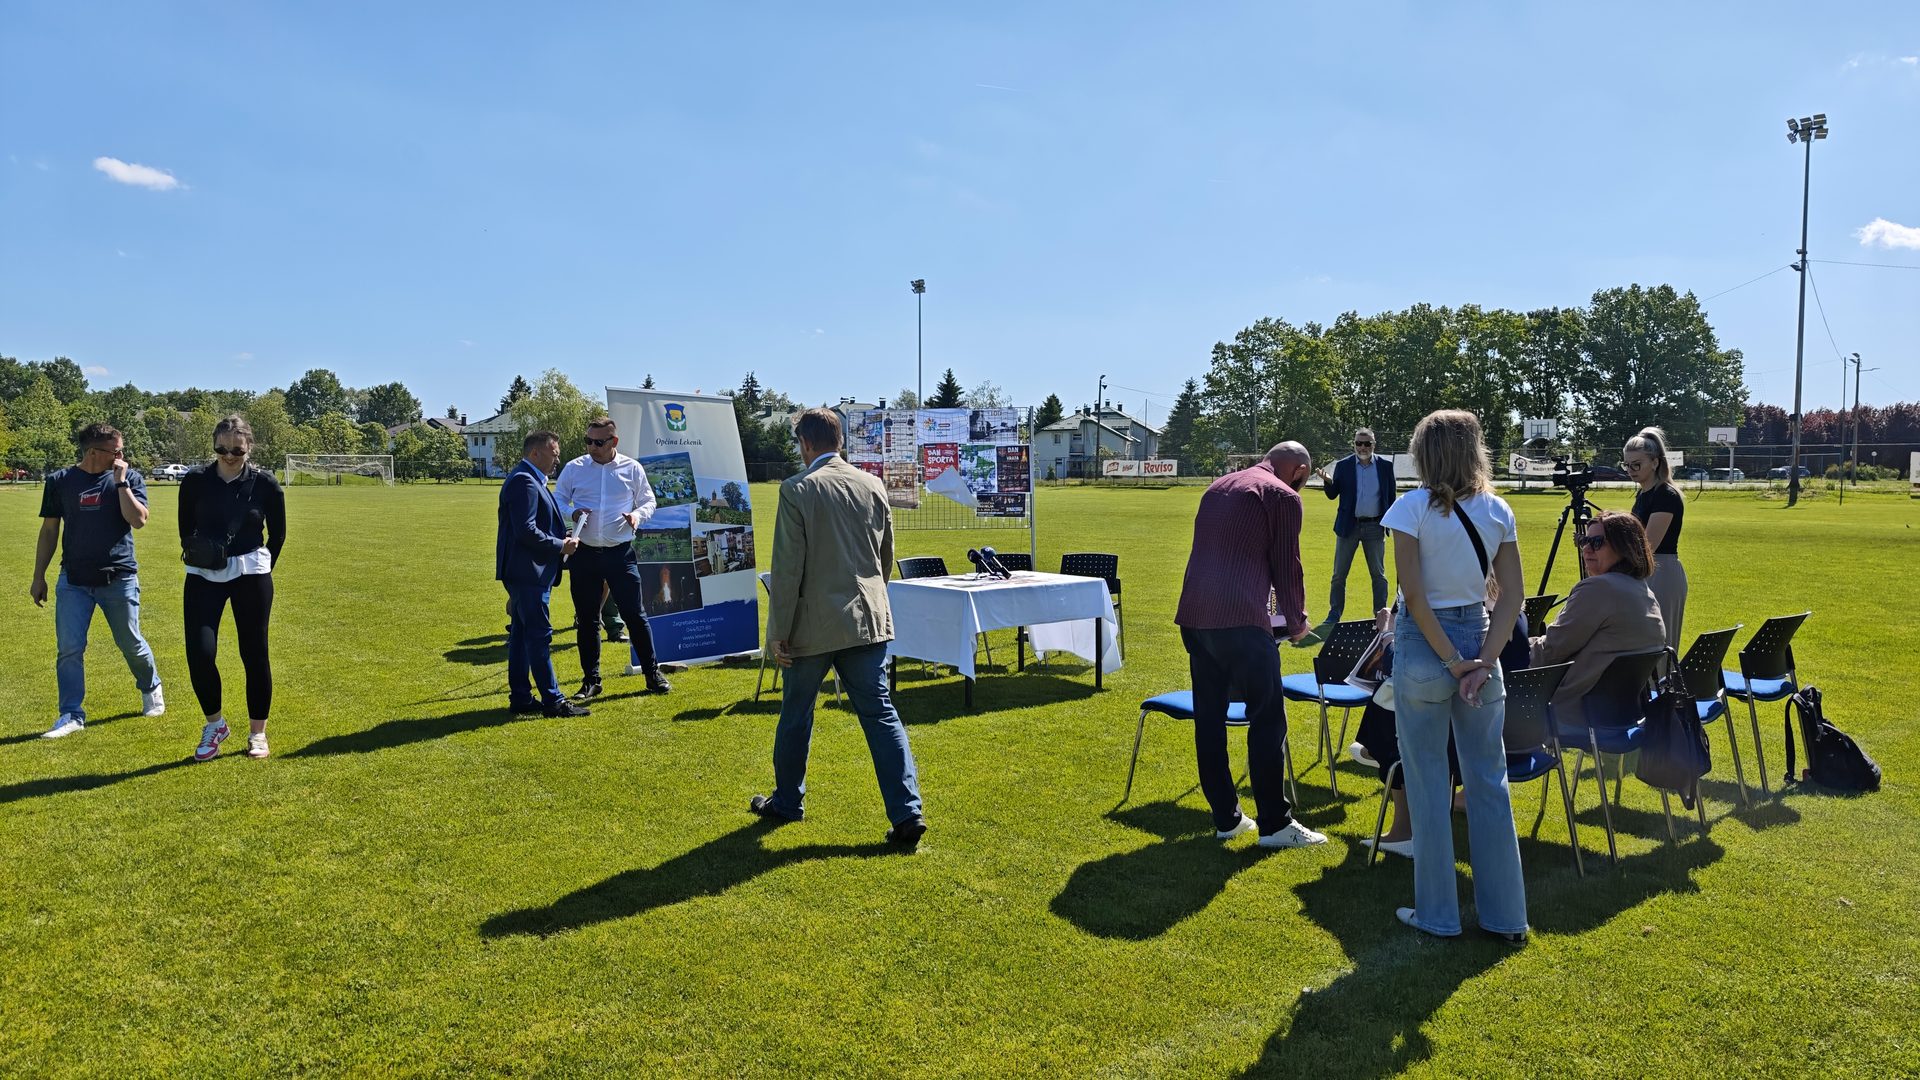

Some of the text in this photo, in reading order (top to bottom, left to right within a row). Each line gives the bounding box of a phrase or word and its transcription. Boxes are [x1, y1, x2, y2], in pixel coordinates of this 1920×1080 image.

[656, 438, 678, 446] Općina
[927, 456, 954, 464] SPORTA
[1144, 461, 1173, 474] Reviso
